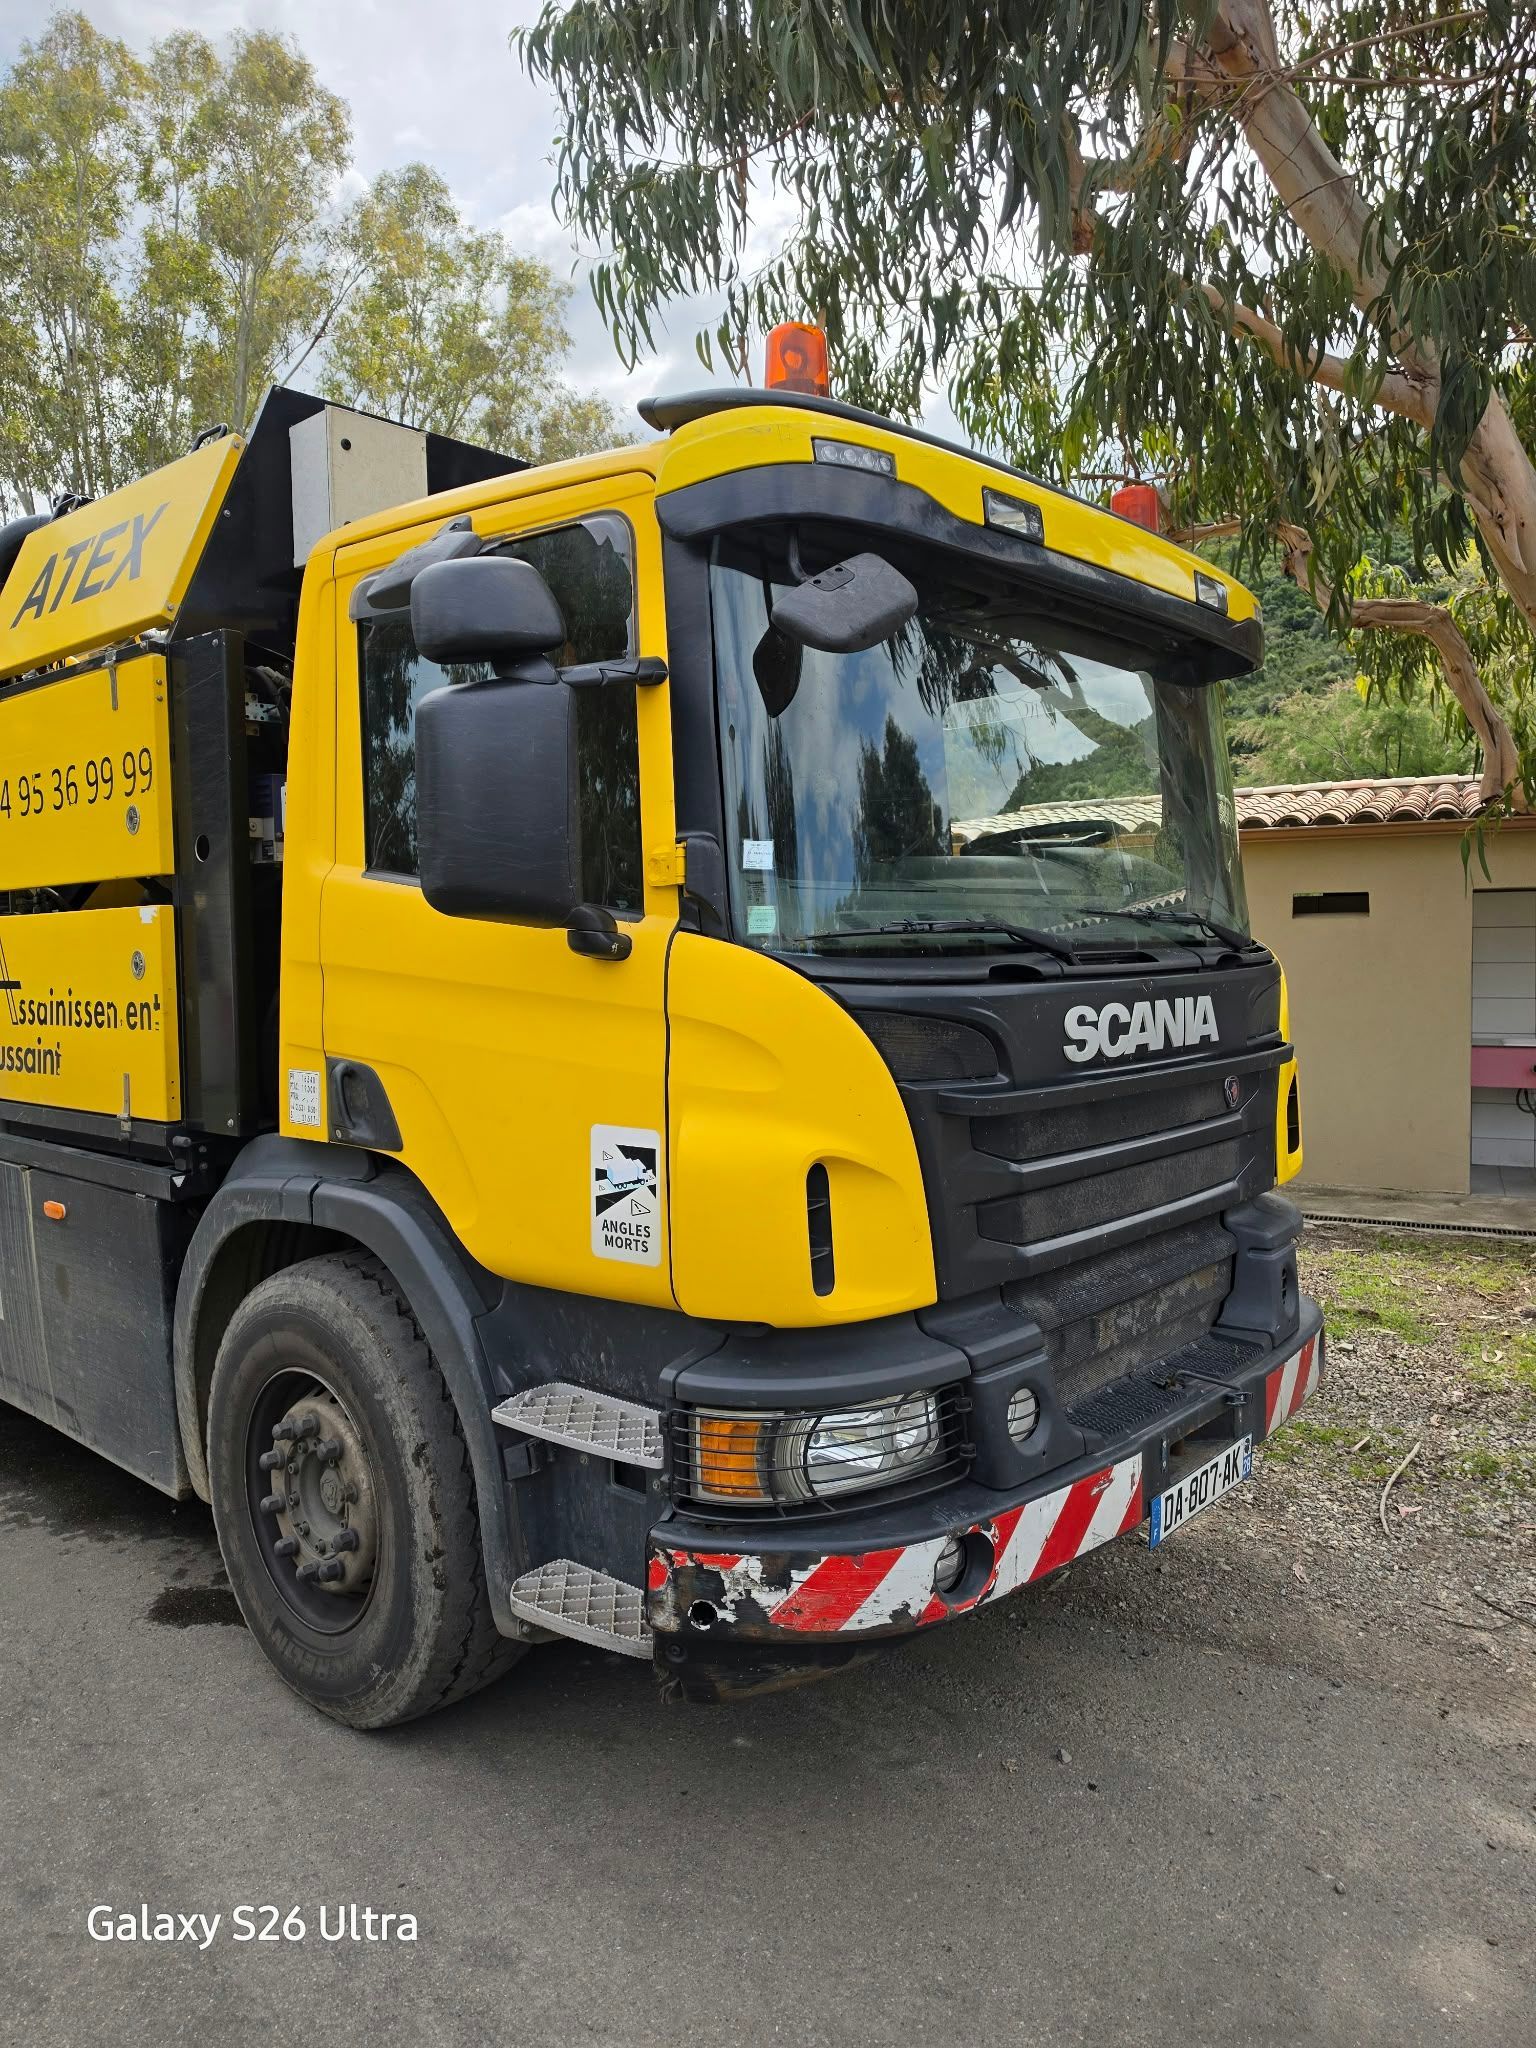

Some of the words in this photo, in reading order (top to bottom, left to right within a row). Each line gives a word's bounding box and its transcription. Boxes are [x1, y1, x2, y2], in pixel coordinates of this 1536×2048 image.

[10, 502, 170, 629] ATEX
[18, 775, 44, 817] 95
[51, 764, 78, 811] 36
[86, 757, 114, 804] 99
[122, 747, 153, 798] 99
[1063, 995, 1220, 1063] SCANIA
[602, 1219, 651, 1238] ANGLES
[604, 1234, 649, 1253] MORTS
[1163, 1445, 1241, 1534] DA-807-AK
